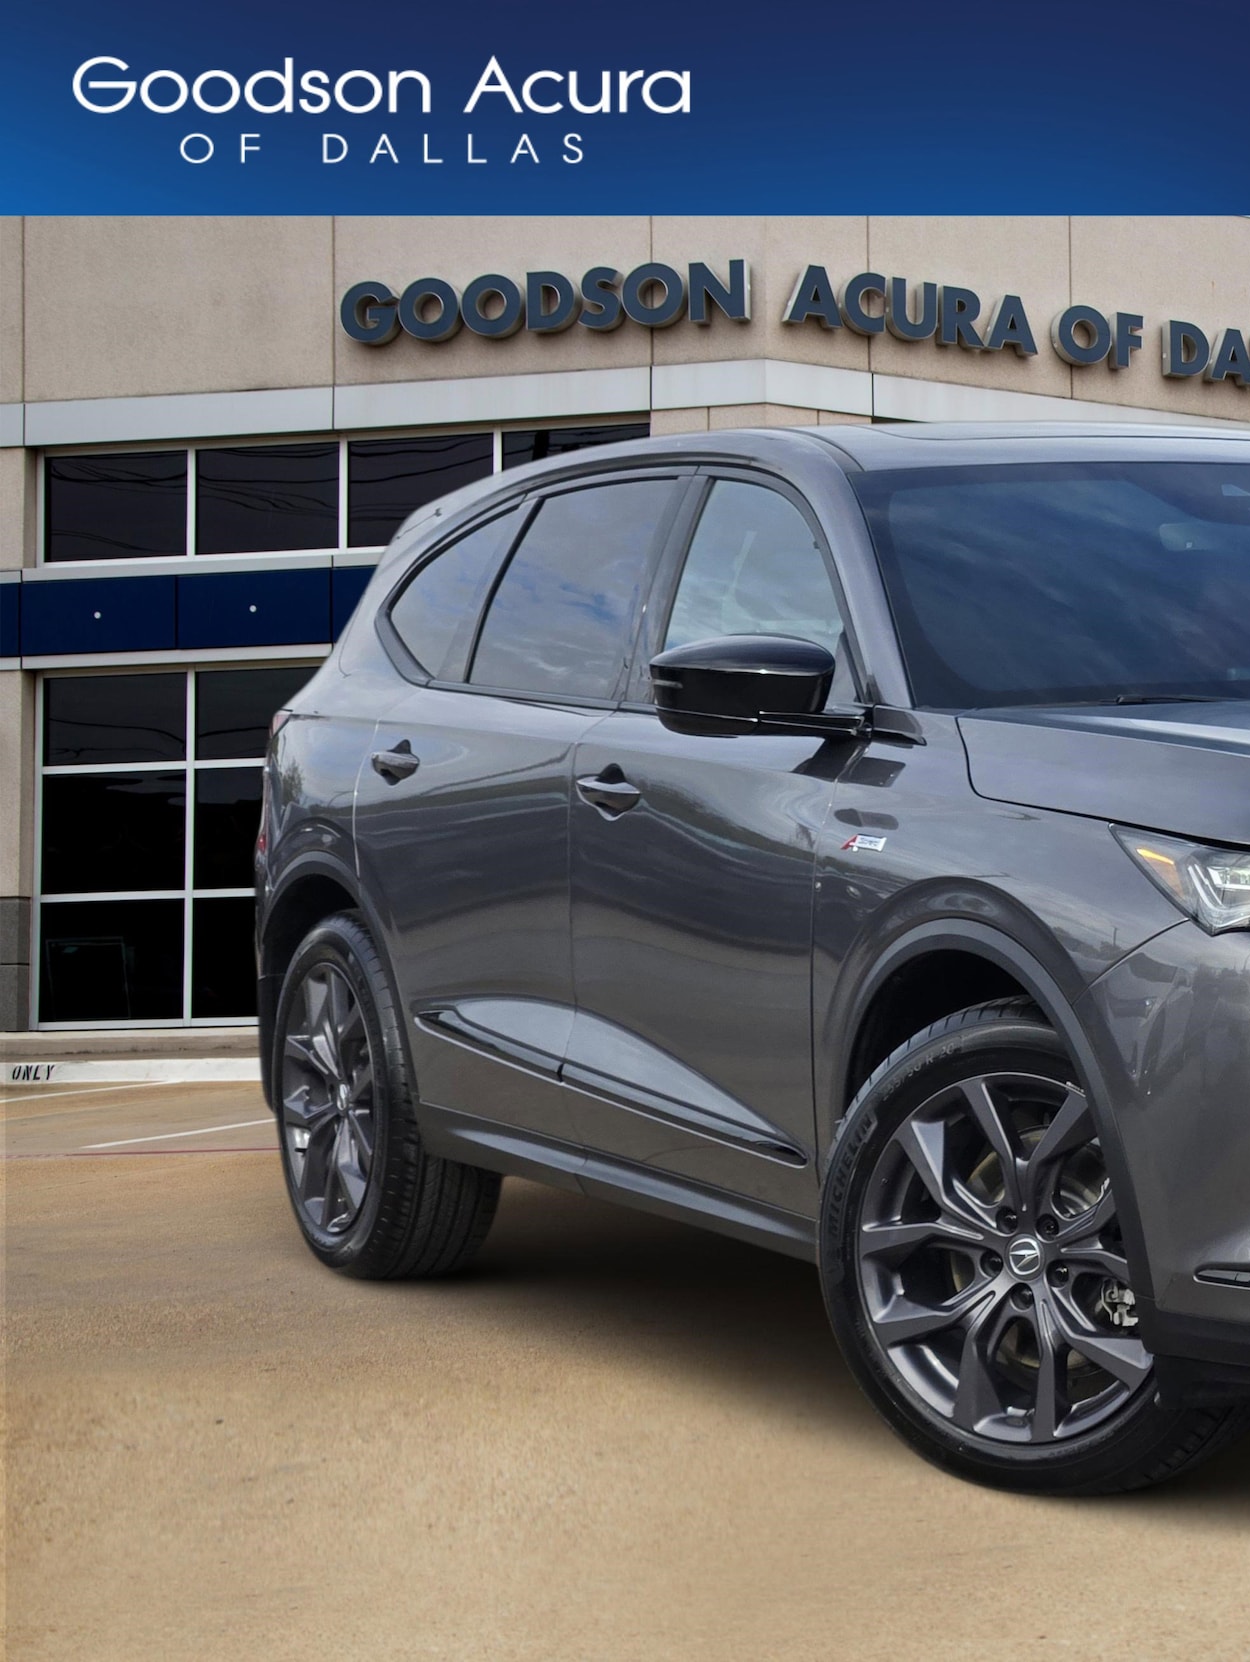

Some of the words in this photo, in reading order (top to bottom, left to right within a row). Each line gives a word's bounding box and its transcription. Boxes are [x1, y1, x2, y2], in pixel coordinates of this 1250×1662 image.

[340, 259, 749, 347] GOODSON
[783, 264, 1038, 357] ACURA
[1052, 305, 1144, 369] OF
[12, 1065, 55, 1081] ONLY
[829, 1112, 873, 1237] MICHELIN
